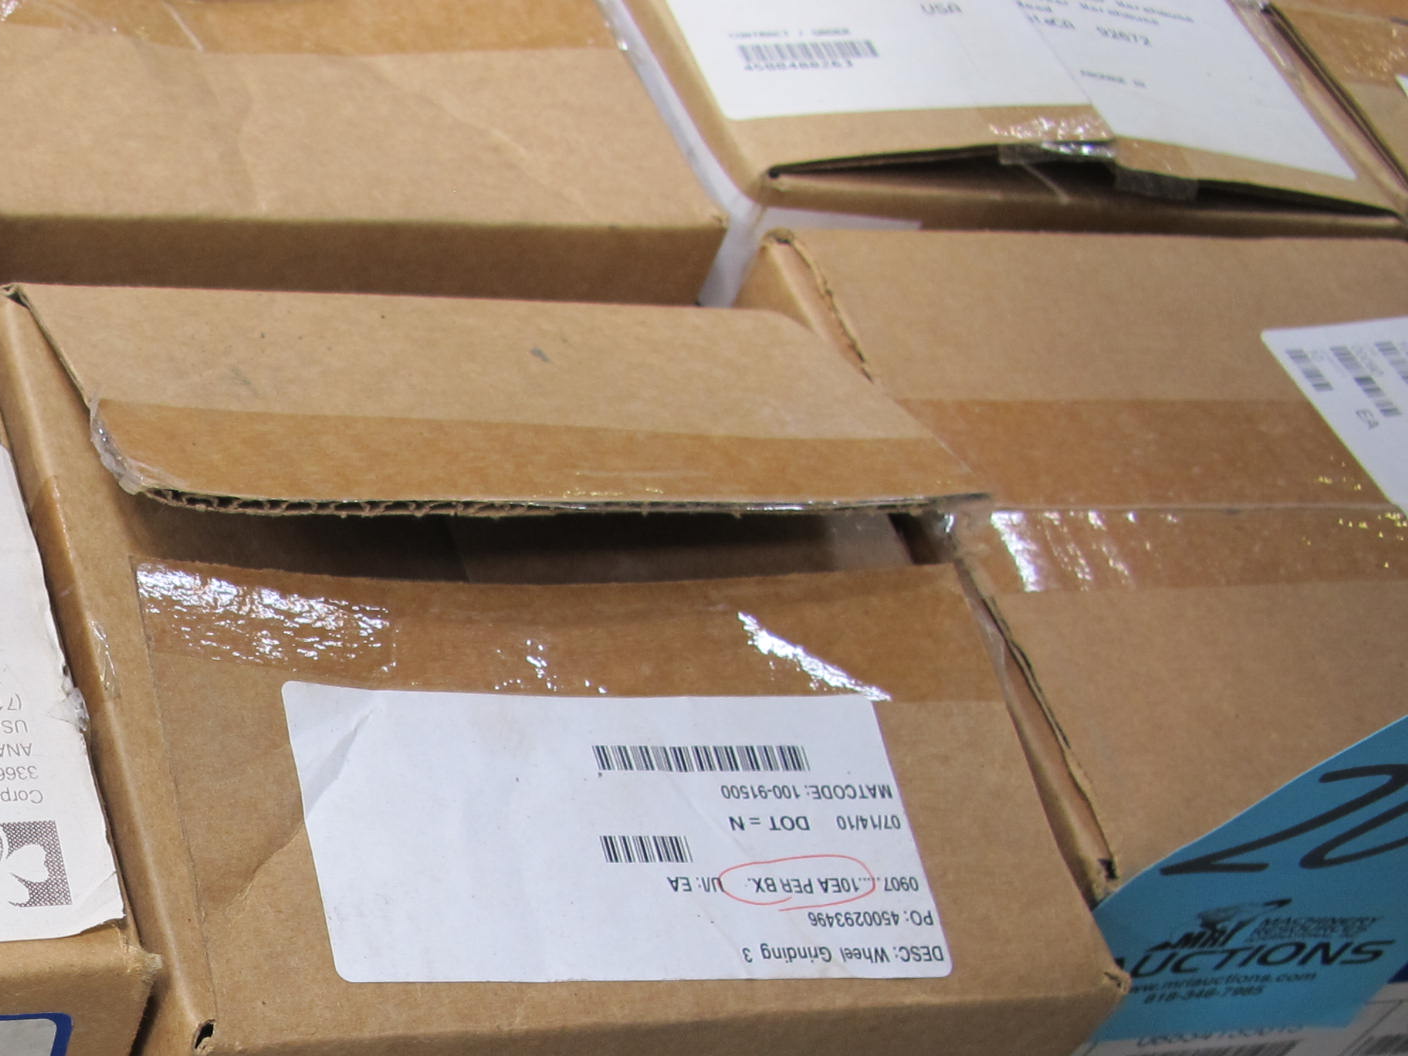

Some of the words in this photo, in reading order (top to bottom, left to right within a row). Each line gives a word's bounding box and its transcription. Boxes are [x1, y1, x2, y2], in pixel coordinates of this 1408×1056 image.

[720, 784, 801, 799] 100-91500
[805, 784, 893, 799] MATCODE:
[729, 816, 745, 831] N
[769, 815, 810, 831] DOT
[836, 814, 901, 830] 07/14/10
[666, 875, 692, 892] EA
[779, 878, 814, 893] PER
[808, 911, 900, 927] 4500293496
[905, 910, 934, 927] PO:
[741, 947, 753, 963] 3
[760, 943, 832, 963] Grinding
[841, 947, 890, 963] Wheel
[893, 945, 945, 962] DESC:
[1115, 939, 1395, 978] UCTIONS
